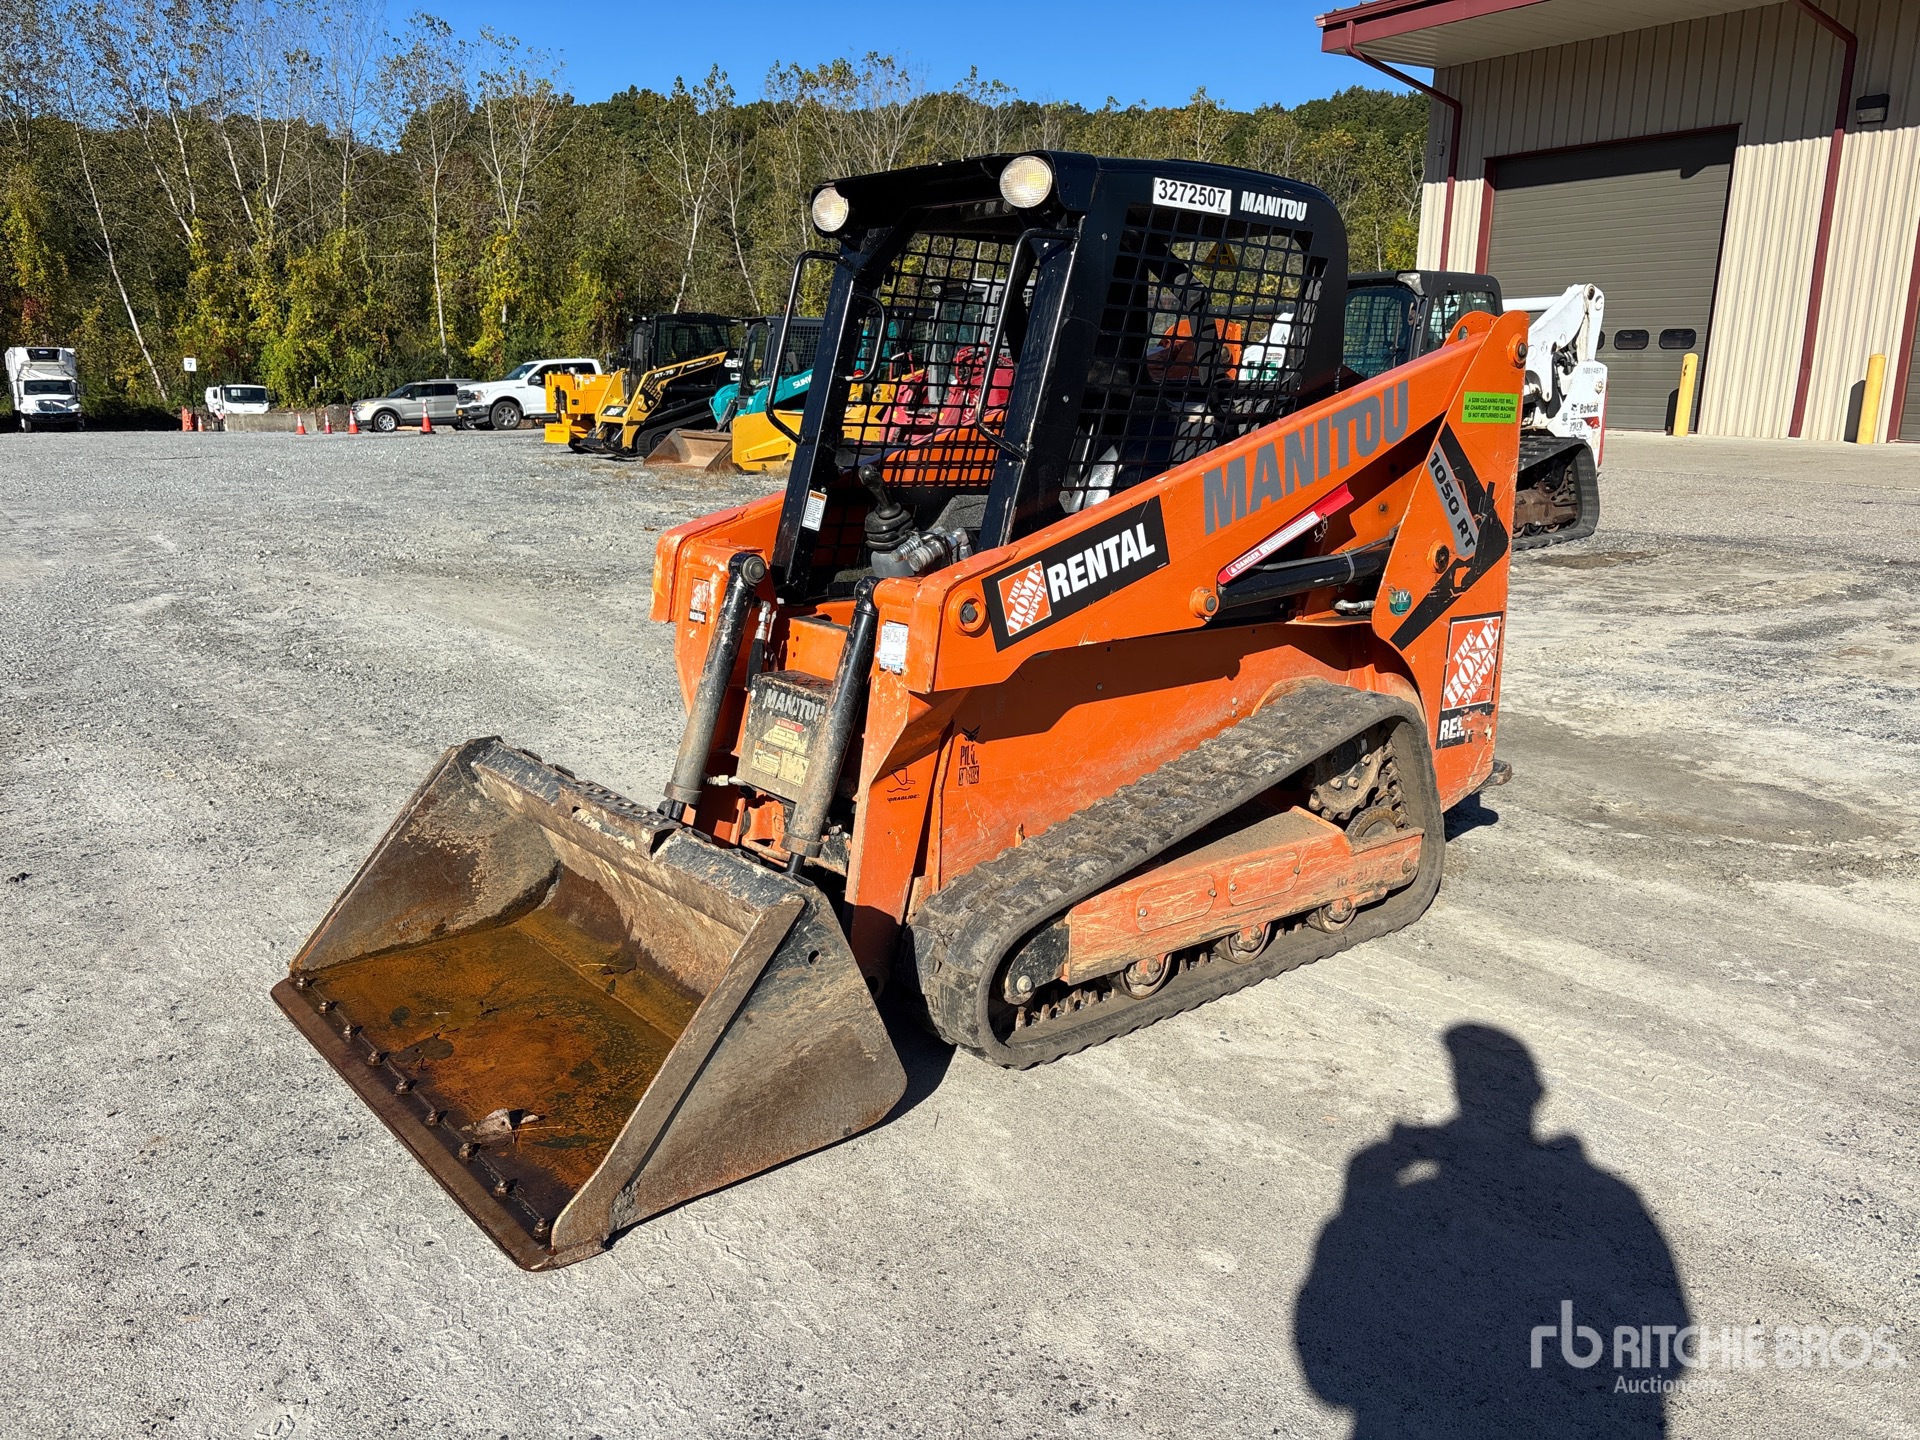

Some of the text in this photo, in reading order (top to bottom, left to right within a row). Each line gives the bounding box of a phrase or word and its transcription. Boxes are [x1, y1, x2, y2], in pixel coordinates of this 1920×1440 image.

[1158, 180, 1226, 208] 3272507
[1240, 191, 1308, 222] MANITOU
[1202, 379, 1409, 536] MANITOU
[1430, 451, 1476, 548] 1050 RT
[1046, 522, 1156, 604] RENTAL
[1235, 550, 1261, 569] DANGER
[1006, 578, 1024, 605] THE
[1006, 564, 1045, 632] HOME
[1024, 583, 1047, 625] DEPOT
[1444, 620, 1499, 708] HOME
[1453, 628, 1477, 666] THE
